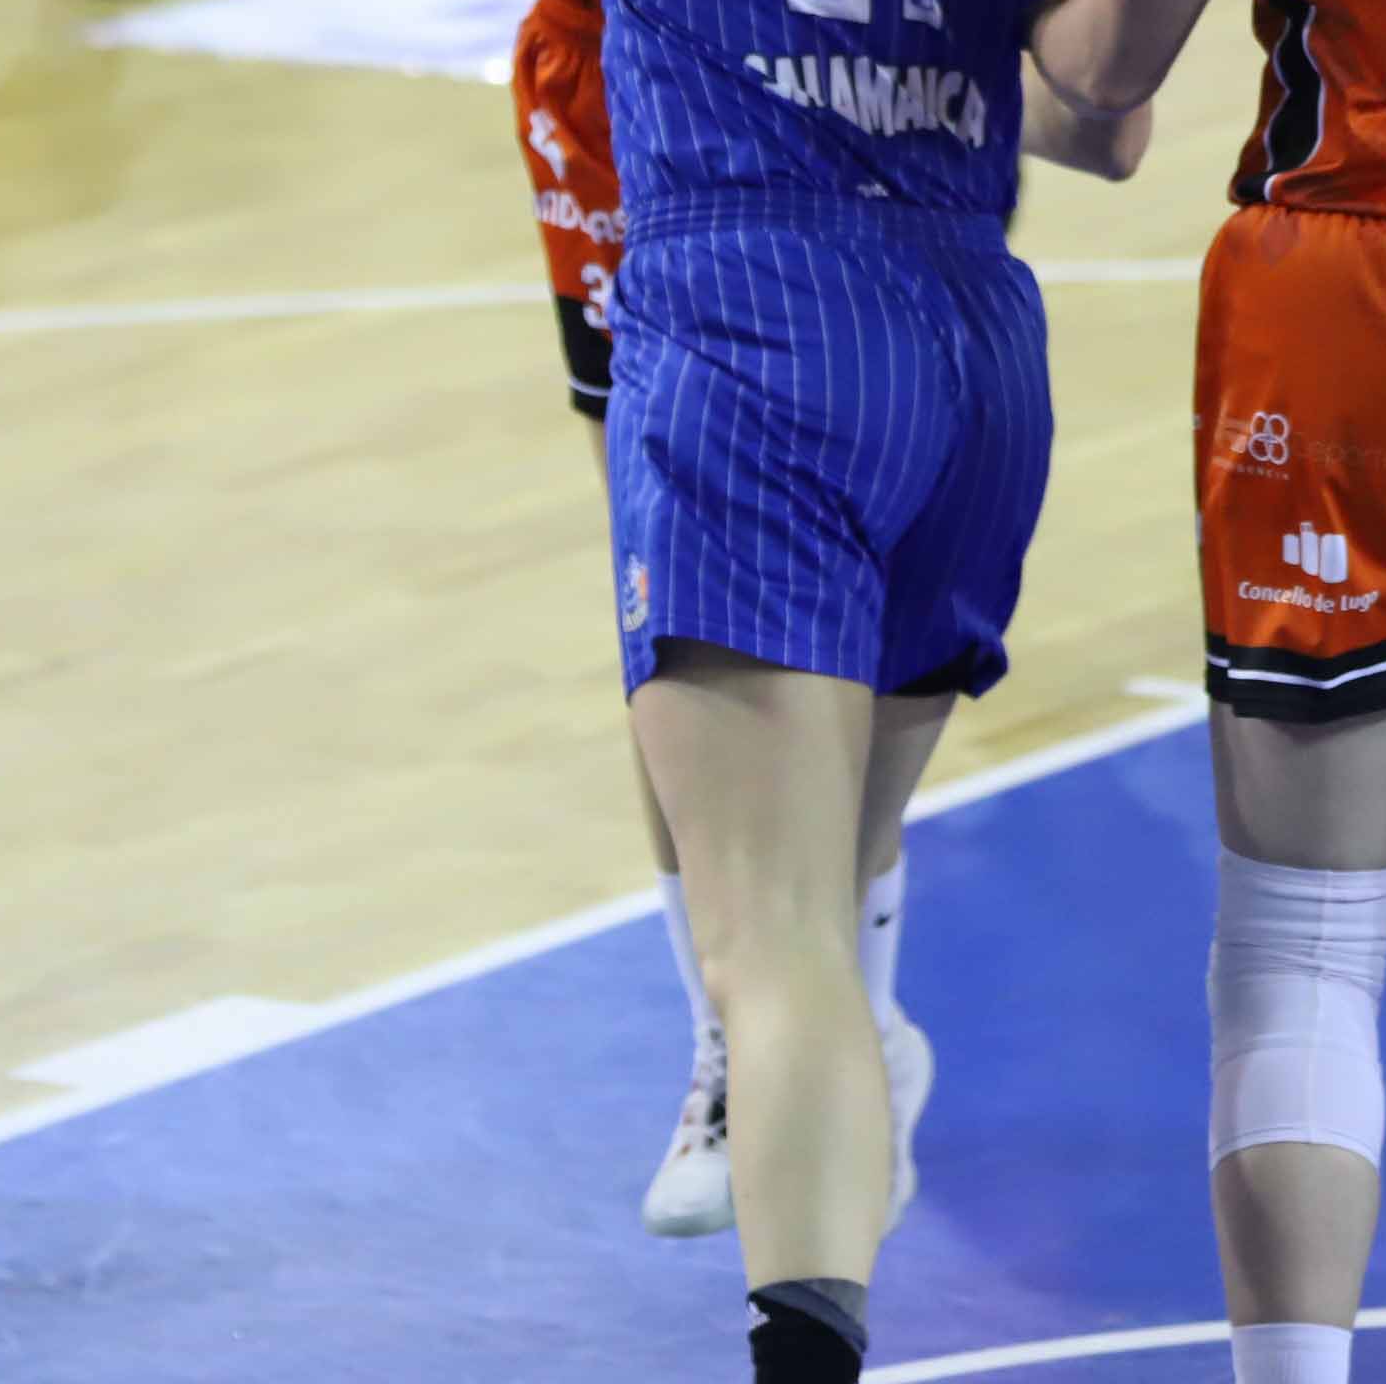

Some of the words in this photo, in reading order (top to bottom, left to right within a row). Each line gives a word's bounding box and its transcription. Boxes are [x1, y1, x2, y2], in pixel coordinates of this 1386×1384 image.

[1237, 581, 1312, 608] Concello
[1315, 592, 1334, 613] de
[1341, 590, 1380, 612] Lugo
